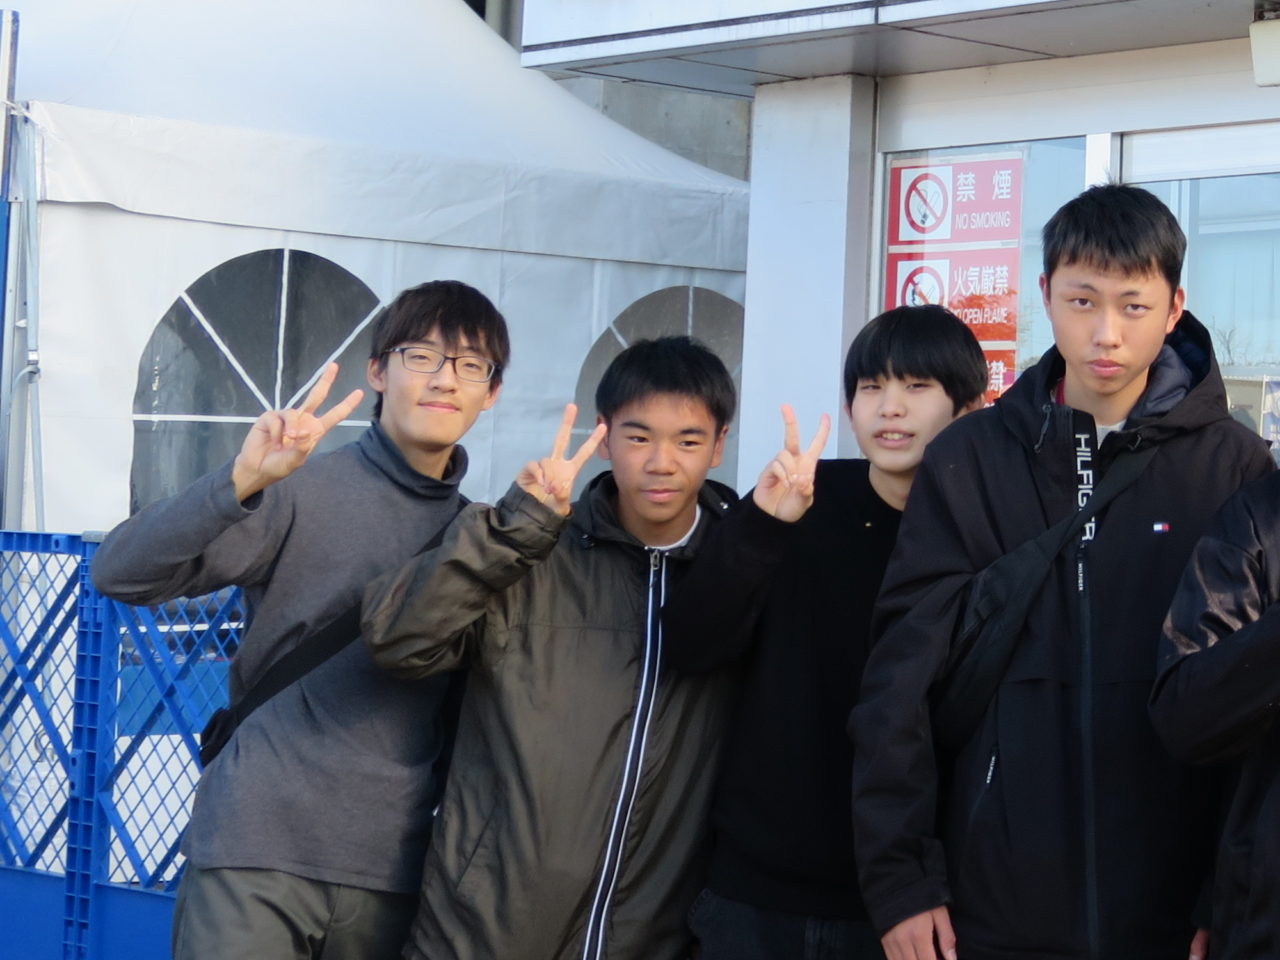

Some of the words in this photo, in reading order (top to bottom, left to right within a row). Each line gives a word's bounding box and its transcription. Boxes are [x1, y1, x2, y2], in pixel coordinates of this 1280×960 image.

[955, 169, 1012, 203] 禁煙
[955, 214, 968, 230] NO
[970, 210, 1011, 229] SMOKING
[952, 265, 1010, 297] 火気厳禁
[1074, 433, 1096, 541] HILFIGR
